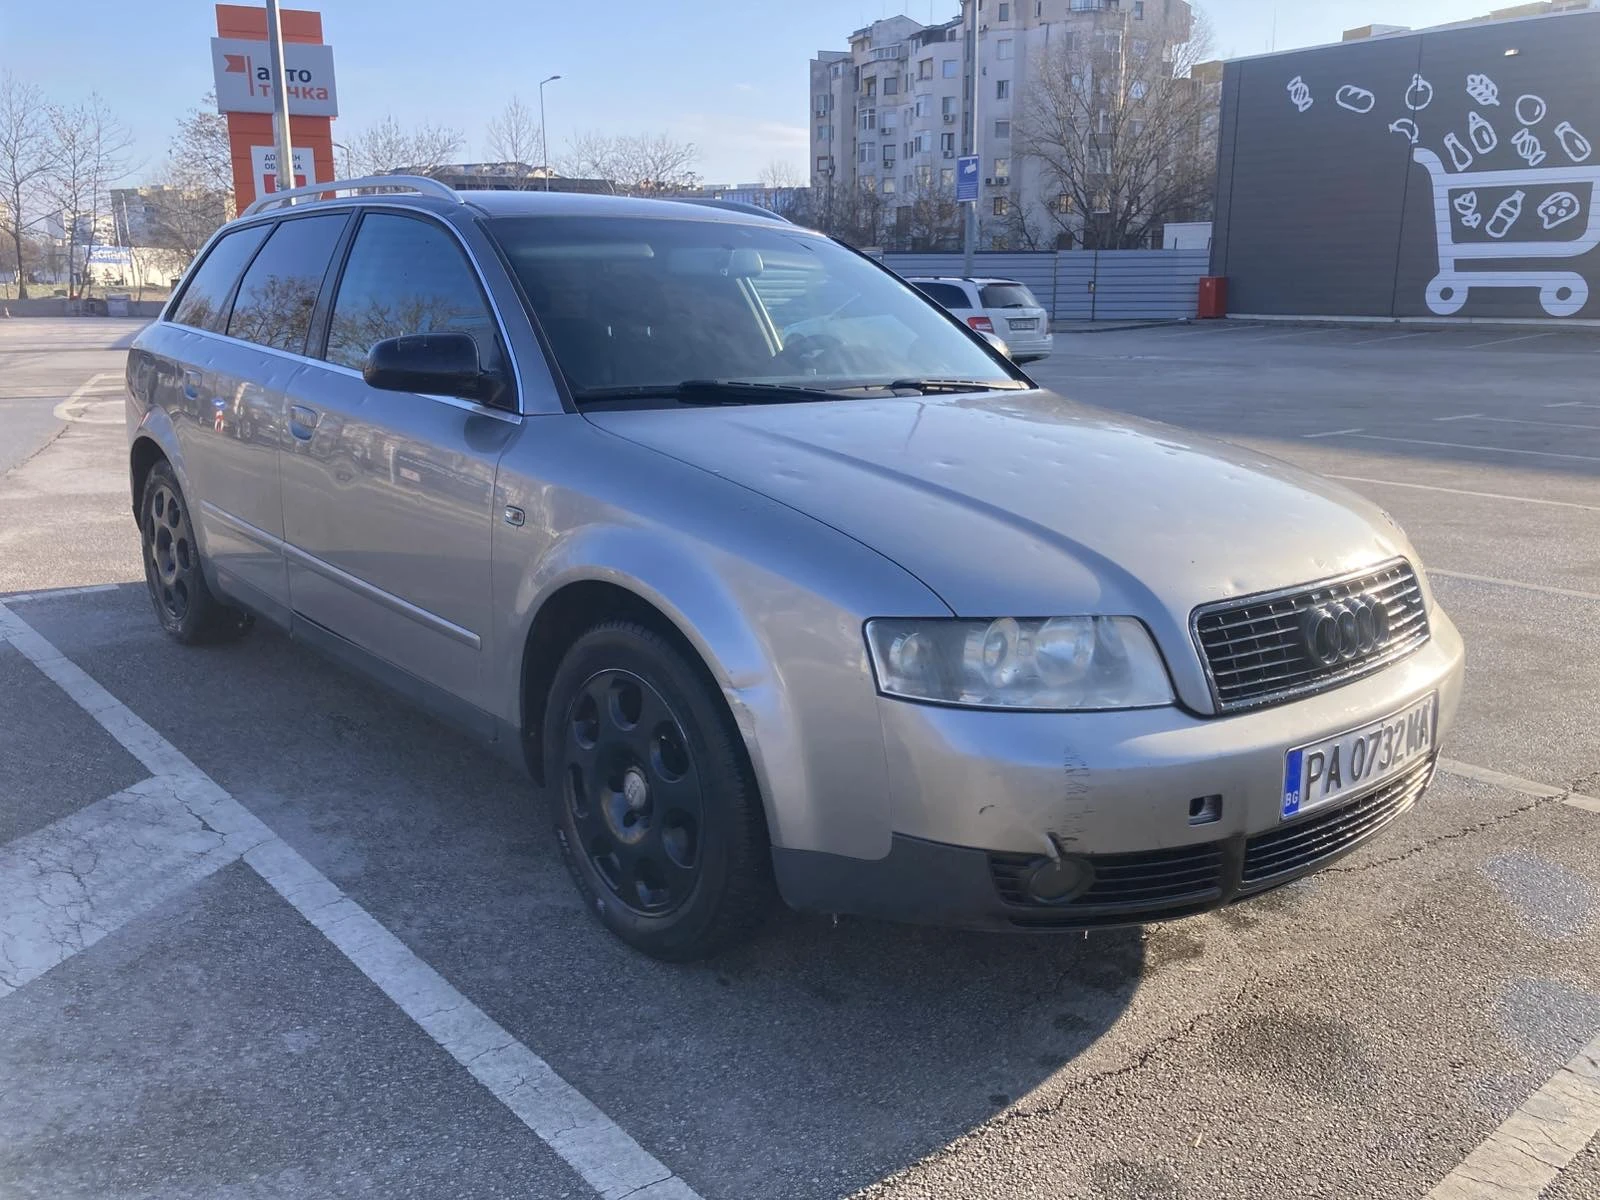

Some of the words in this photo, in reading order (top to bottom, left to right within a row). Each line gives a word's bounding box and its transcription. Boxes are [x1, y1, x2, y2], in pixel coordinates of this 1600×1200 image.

[257, 67, 312, 83] ато
[258, 84, 328, 100] тчка
[1304, 744, 1341, 800] PA
[1350, 718, 1406, 781] 0732
[1285, 791, 1299, 806] BG
